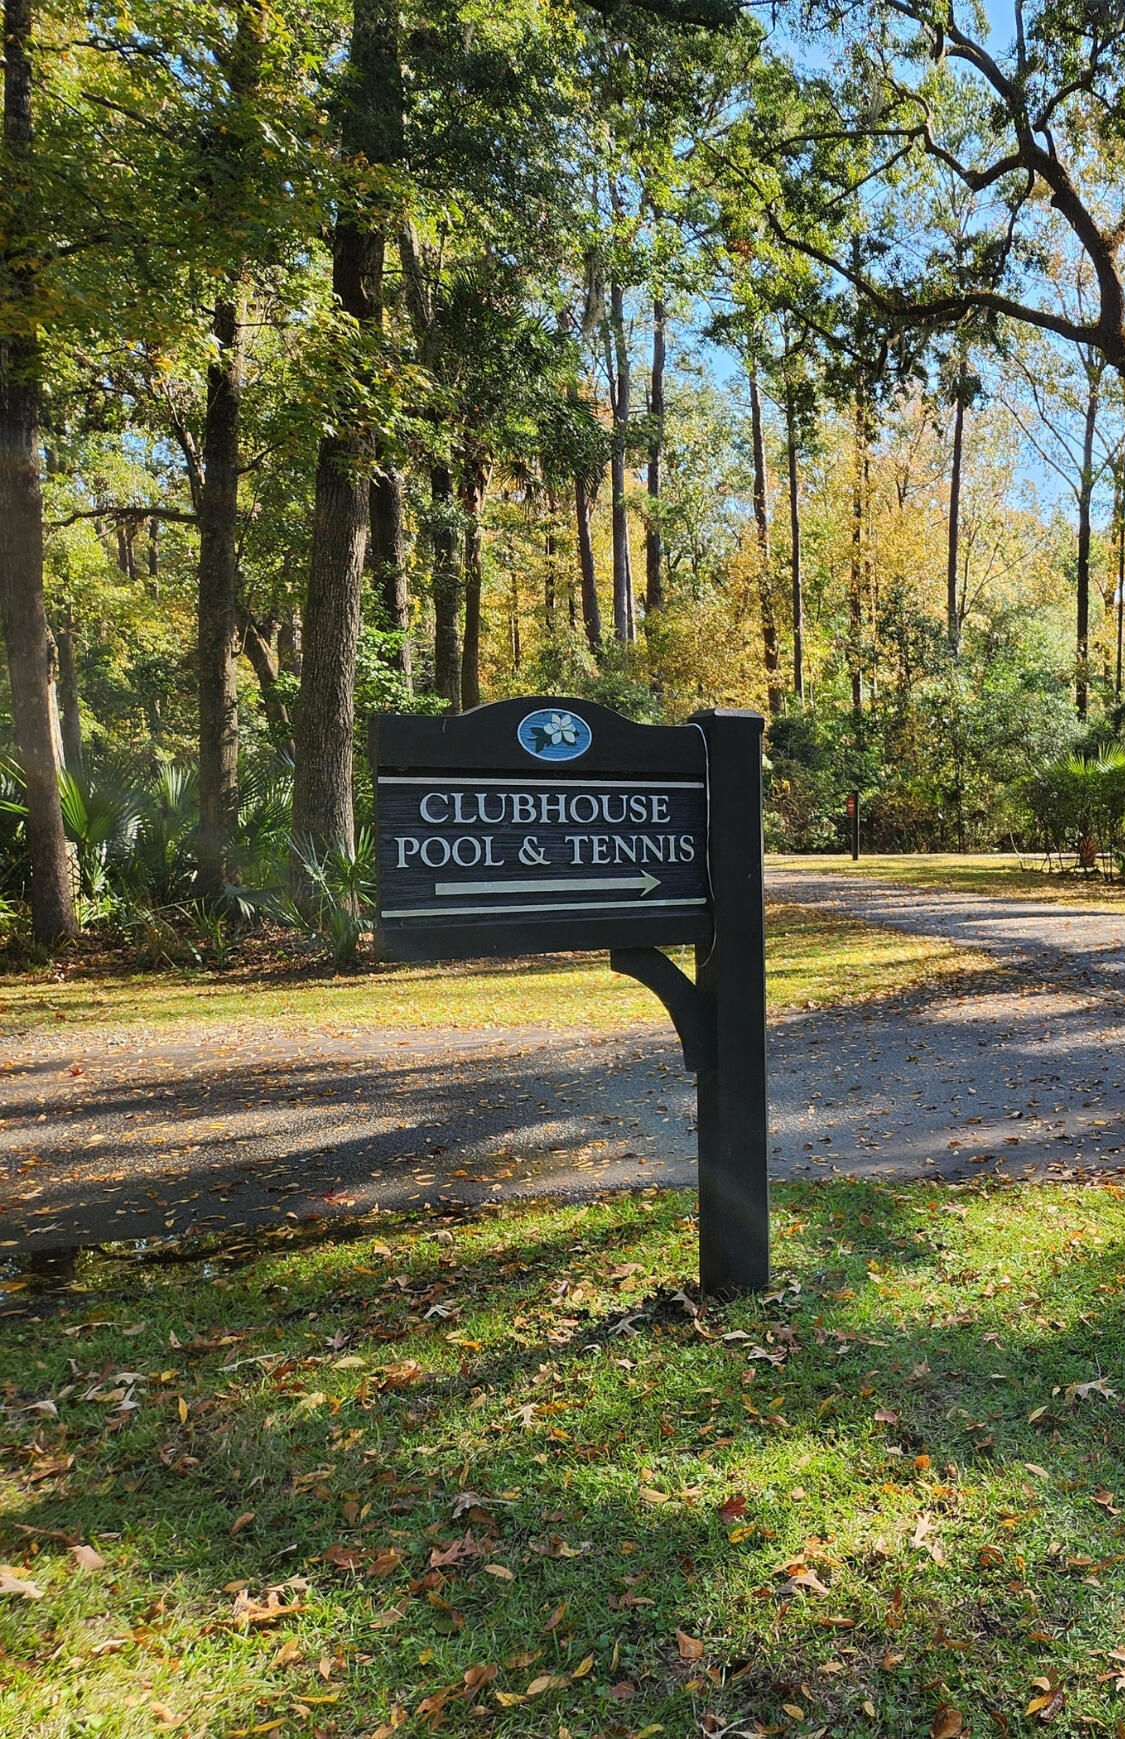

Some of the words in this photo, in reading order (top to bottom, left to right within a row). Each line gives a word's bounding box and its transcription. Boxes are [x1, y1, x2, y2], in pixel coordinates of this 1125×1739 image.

[420, 792, 671, 824] CLUBHOUSE
[395, 836, 504, 868] POOL
[518, 836, 551, 866] &
[565, 834, 695, 865] TENNIS
